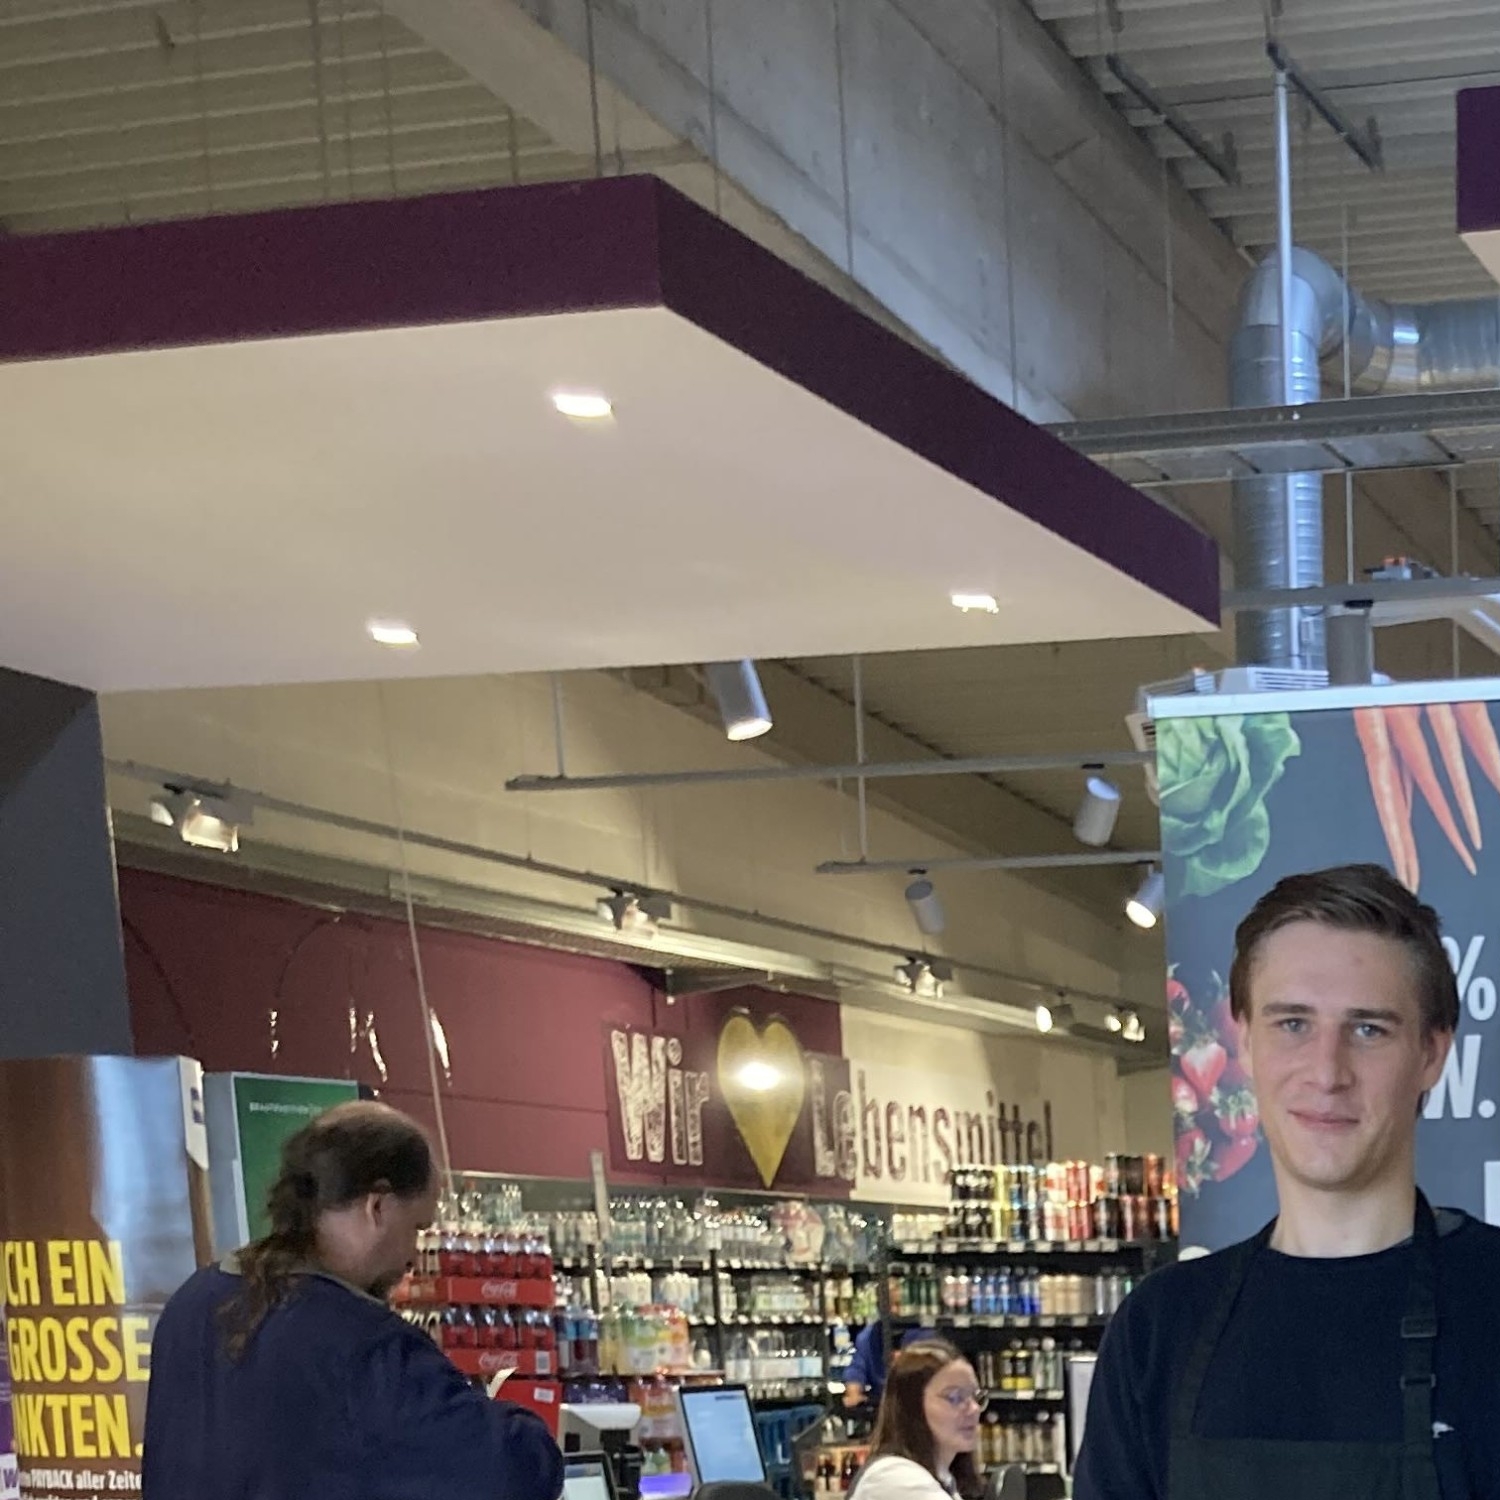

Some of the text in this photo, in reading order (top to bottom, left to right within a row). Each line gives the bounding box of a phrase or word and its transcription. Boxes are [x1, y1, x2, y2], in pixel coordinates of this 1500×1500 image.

[611, 1030, 1053, 1186] Wir Lebensmittel
[48, 1240, 126, 1305] EIN
[7, 1316, 151, 1382] GROSSE
[76, 1470, 104, 1489] aller
